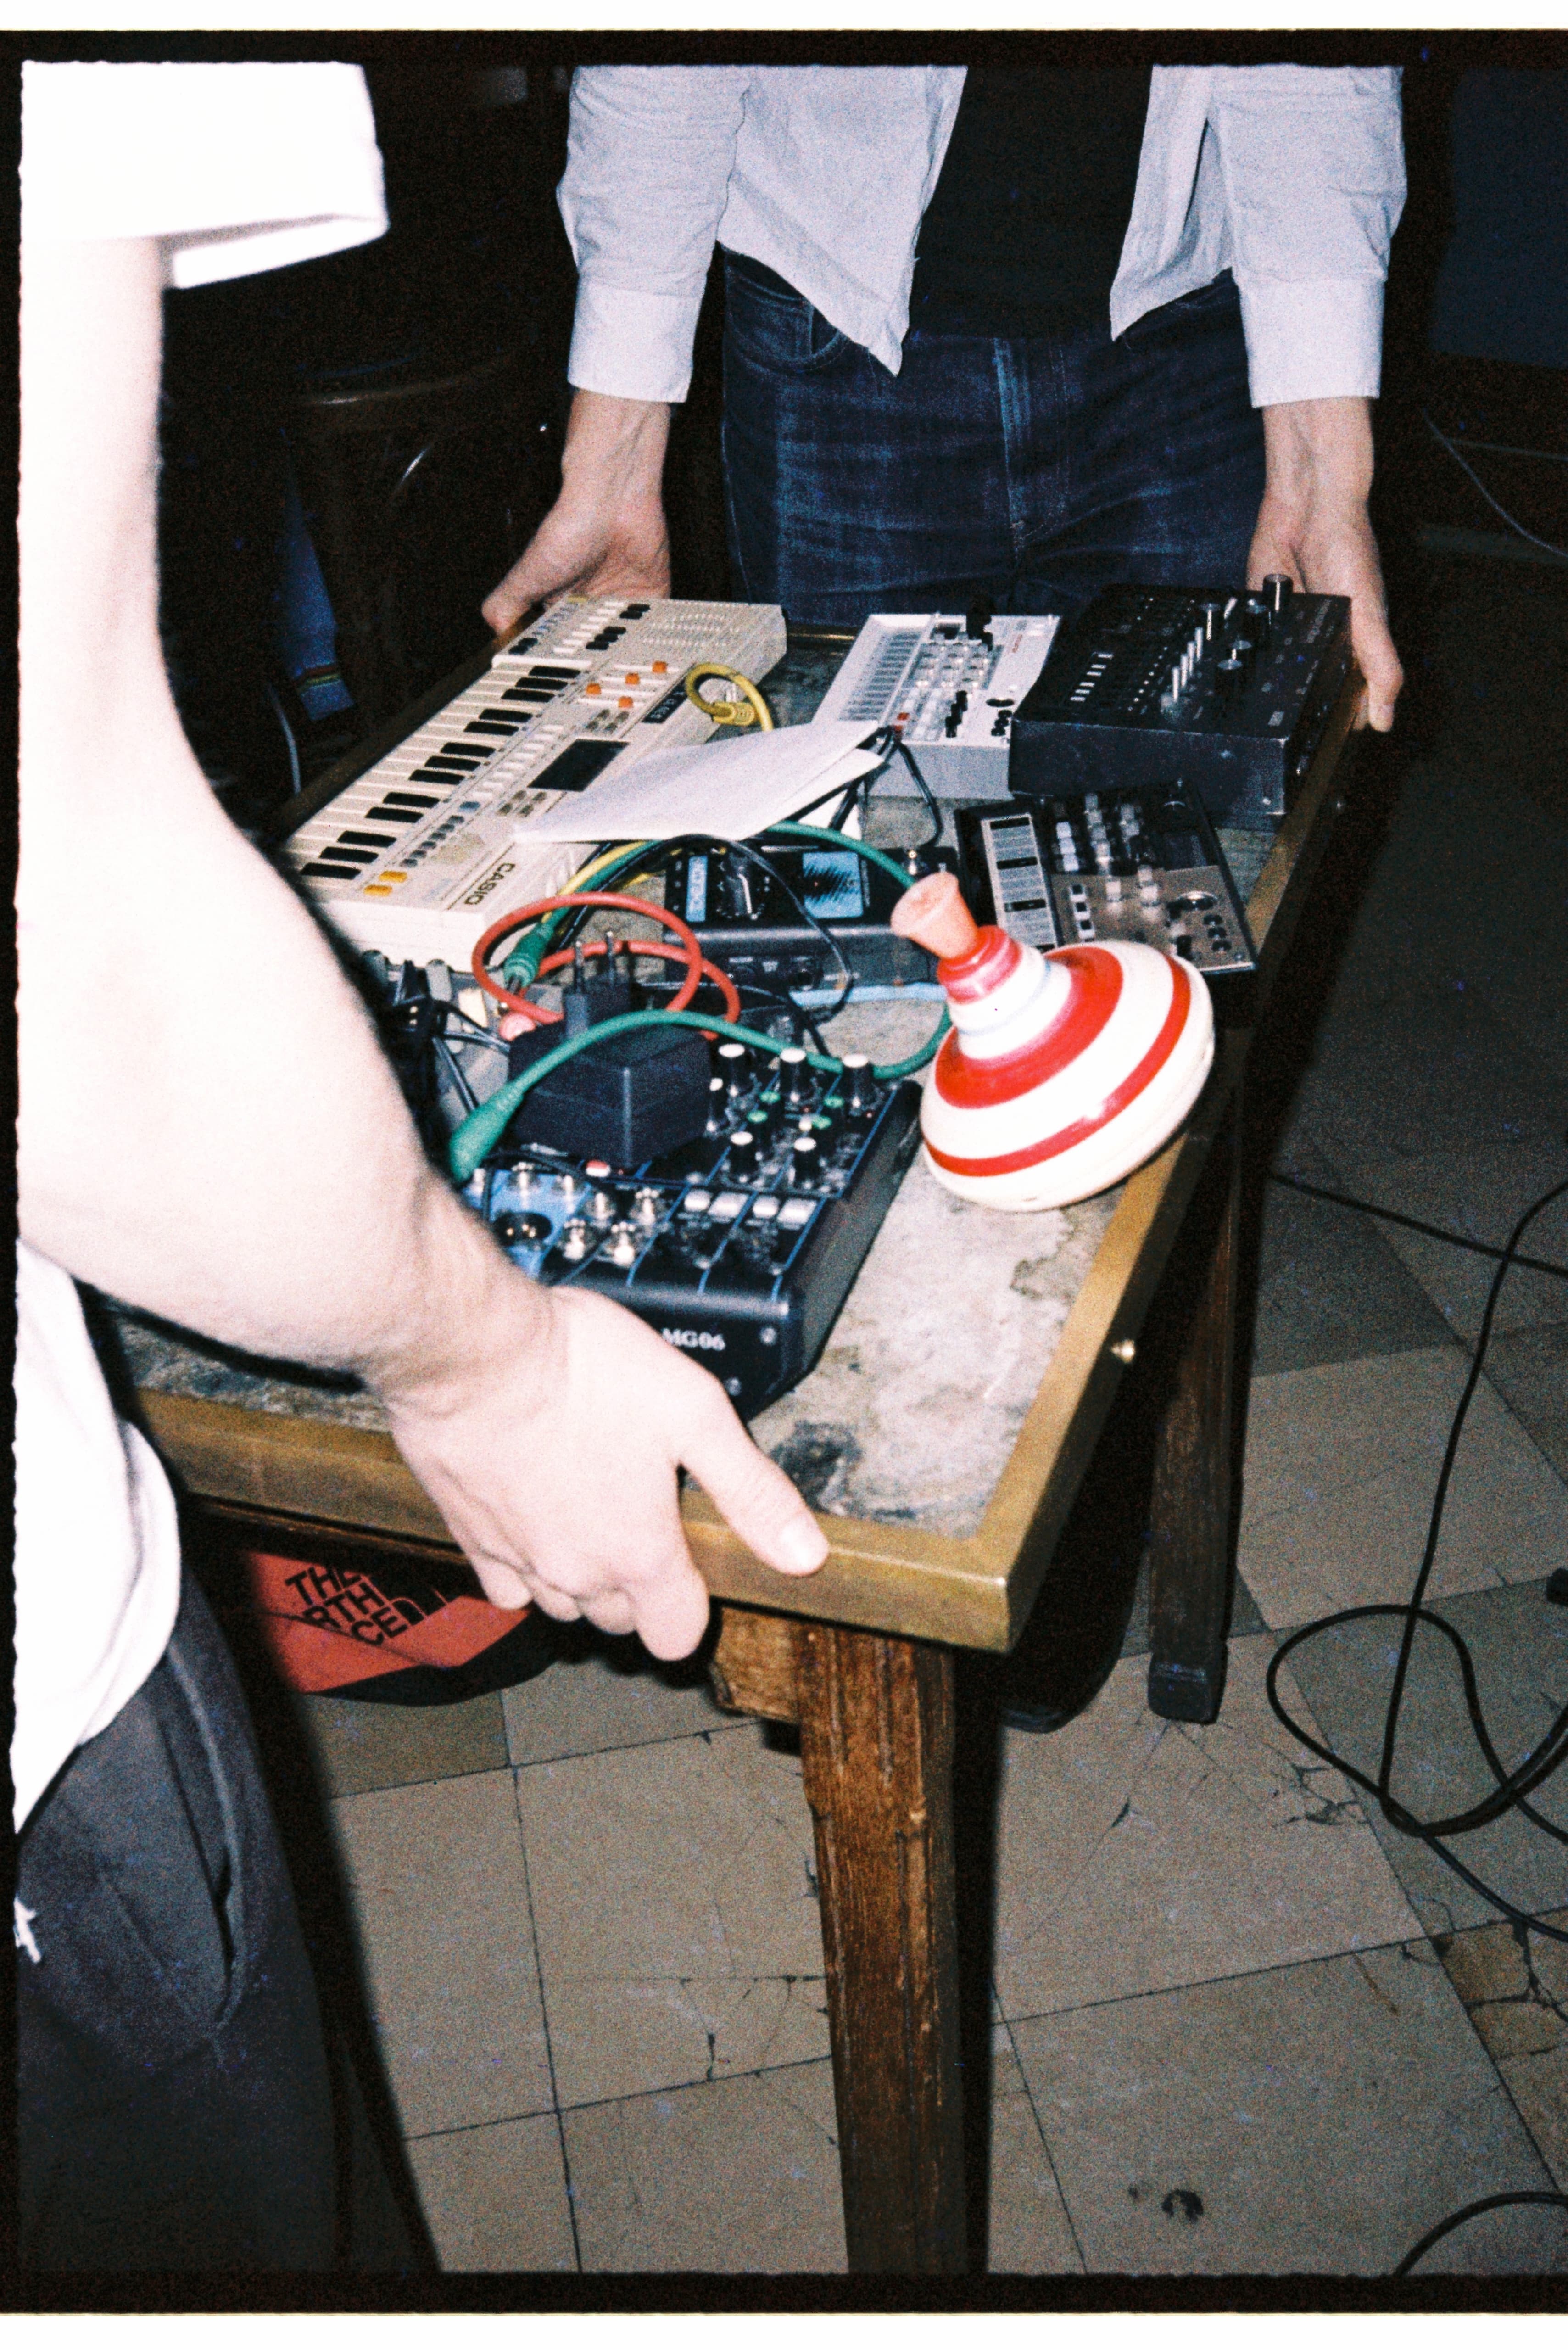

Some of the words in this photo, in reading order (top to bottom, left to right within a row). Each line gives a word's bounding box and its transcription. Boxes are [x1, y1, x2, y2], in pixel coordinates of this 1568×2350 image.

[464, 862, 516, 905] CASIO
[662, 1328, 726, 1352] MG06
[302, 1582, 385, 1628] RTH
[350, 1606, 408, 1646] CE
